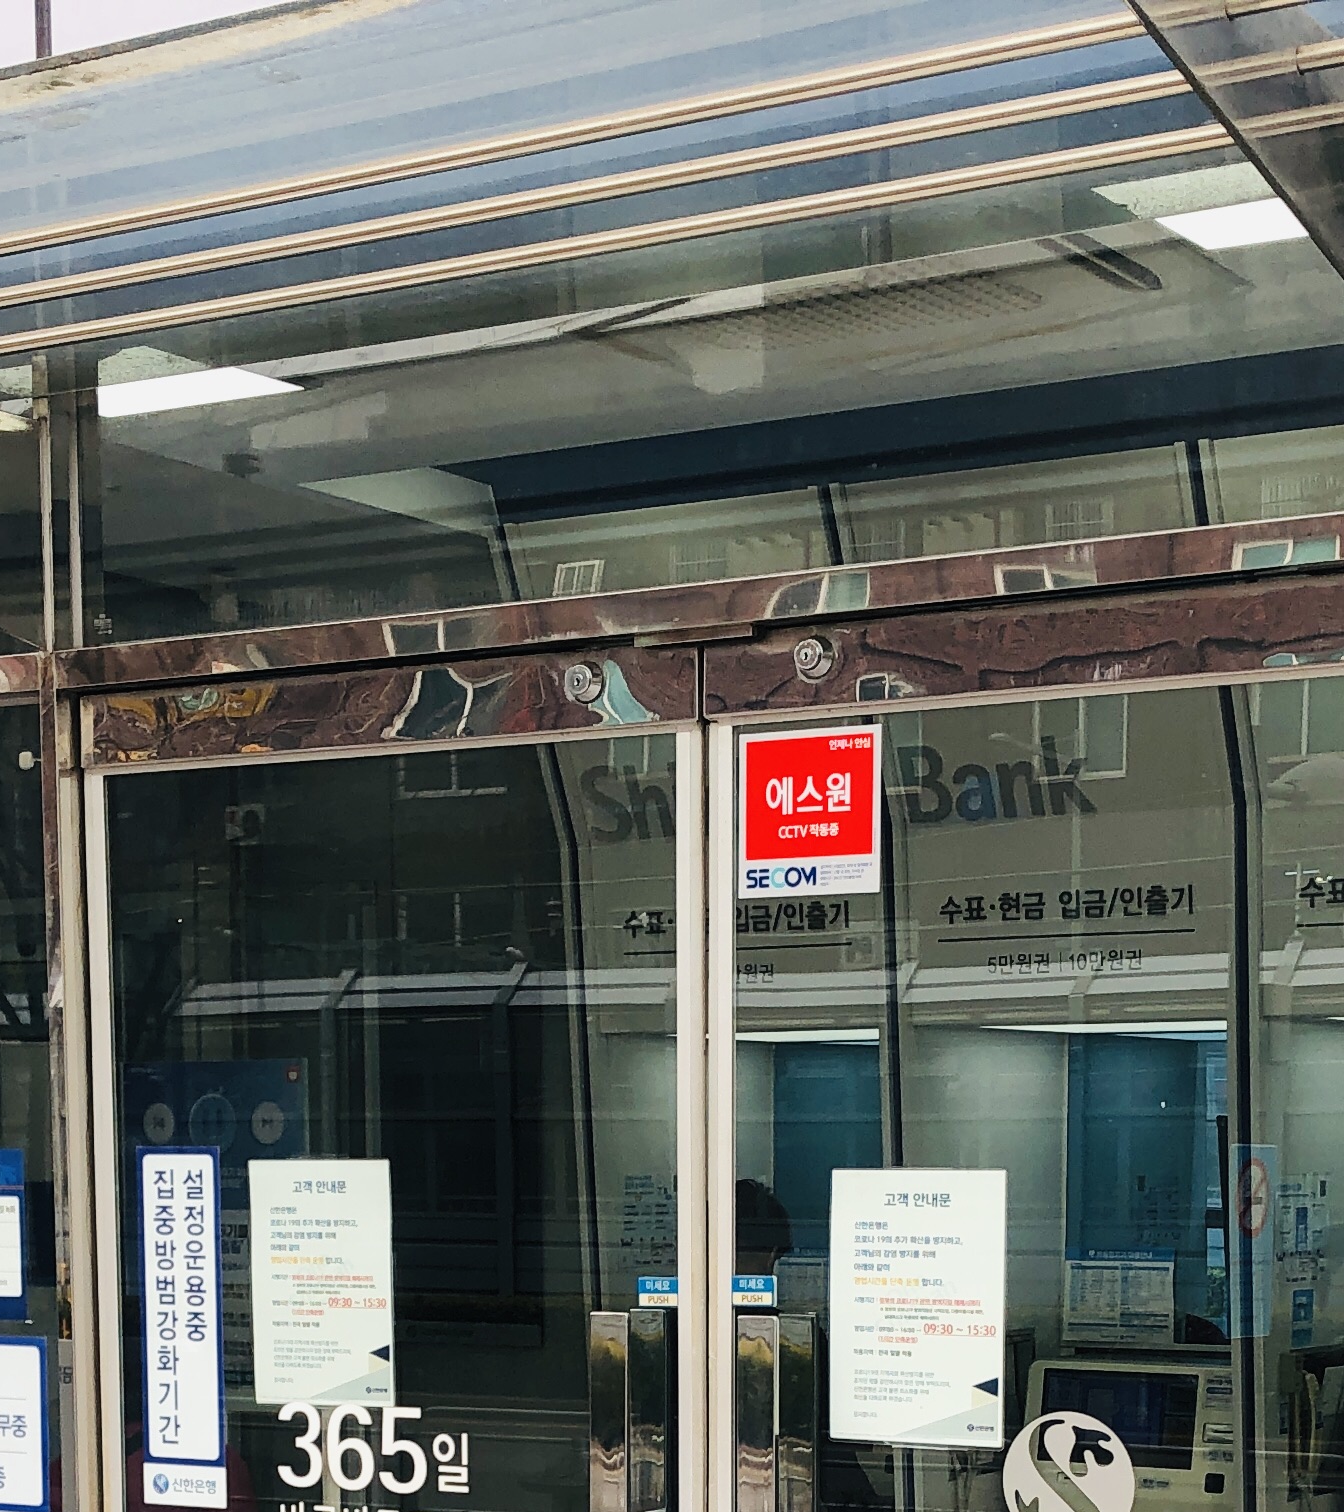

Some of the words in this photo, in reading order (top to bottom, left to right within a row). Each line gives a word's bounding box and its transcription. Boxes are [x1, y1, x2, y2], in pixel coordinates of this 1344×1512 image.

[829, 738, 853, 751] 언제나
[854, 737, 871, 749] 안심
[906, 735, 1097, 827] Bank
[765, 772, 852, 815] 에스원
[778, 824, 808, 839] CCTV
[809, 822, 839, 837] 작동중
[746, 866, 817, 889] SECOM
[939, 890, 1045, 924] 수표·현금
[1058, 884, 1195, 919] 입금/인출기
[987, 952, 1050, 974] 5만원권
[1068, 949, 1143, 972] 10만원권
[292, 1181, 313, 1194] 고객
[316, 1181, 347, 1194] 안내문
[884, 1193, 909, 1208] 고객
[913, 1193, 952, 1208] 안내문
[183, 1169, 208, 1342] 설정운용중
[153, 1169, 181, 1445] 집중방범강화기간
[328, 1297, 353, 1308] 09:30
[362, 1297, 387, 1309] 15:30
[648, 1295, 669, 1304] PUSH
[741, 1294, 763, 1303] PUSH
[923, 1323, 953, 1335] 09:30
[967, 1324, 997, 1336] 15:30
[277, 1401, 470, 1494] 365일
[172, 1477, 217, 1495] 신한은행
